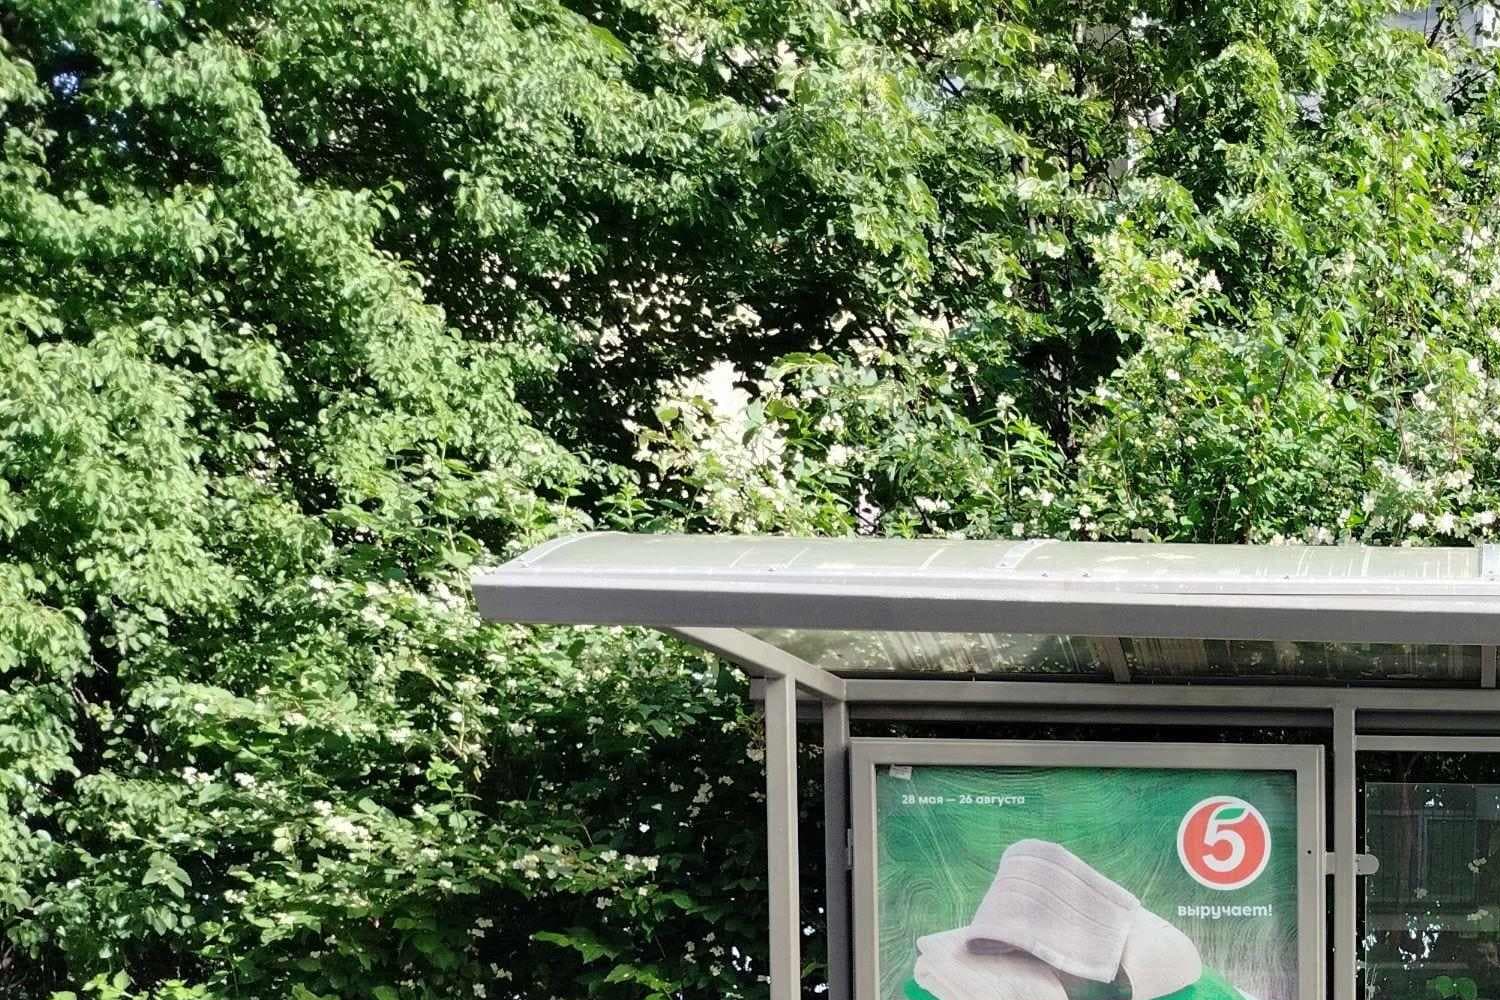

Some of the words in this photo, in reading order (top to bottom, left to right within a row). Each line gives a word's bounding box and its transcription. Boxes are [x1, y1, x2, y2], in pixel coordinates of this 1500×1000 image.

[901, 794, 915, 805] 28
[918, 795, 943, 805] мая
[959, 794, 973, 805] 26
[975, 795, 1025, 807] августа
[1202, 806, 1252, 873] 5
[1177, 903, 1273, 919] выручает!
